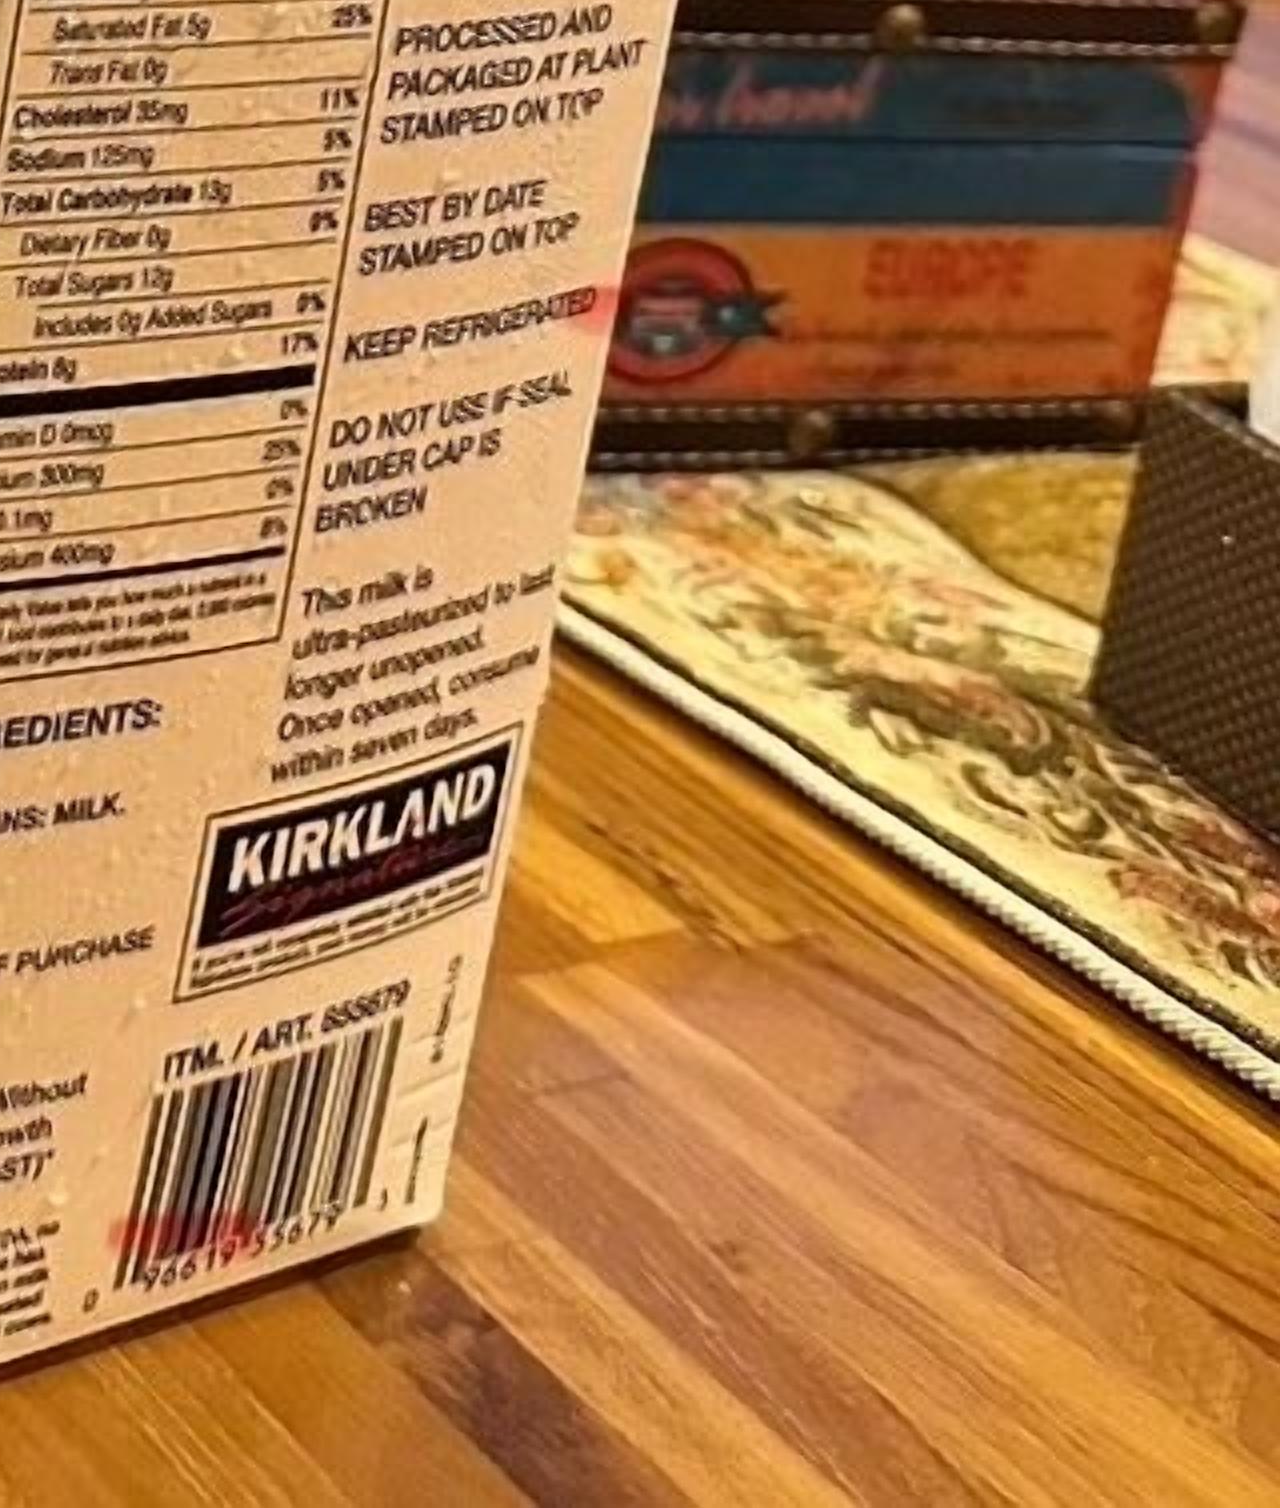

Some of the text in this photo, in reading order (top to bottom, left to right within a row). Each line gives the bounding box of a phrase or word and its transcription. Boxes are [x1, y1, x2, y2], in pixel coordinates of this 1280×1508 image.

[53, 16, 147, 42] Saturated
[151, 13, 184, 39] Fat
[394, 4, 612, 56] PROCESSED AND
[50, 61, 103, 84] Trans
[107, 59, 139, 82] Fat
[388, 39, 649, 100] PACKAGED AT PLANT
[13, 102, 131, 130] Cholesterol
[320, 88, 360, 110] 11%
[380, 88, 604, 145] STAMPED ON TOP
[7, 148, 85, 172] Sodium
[0, 190, 52, 215] Total
[57, 184, 193, 213] Carbohydrate
[364, 179, 548, 232] BEST BY DATE
[20, 232, 86, 256] Dietary
[92, 228, 141, 250] Fiber
[358, 212, 581, 276] STAMPED ON TOP
[15, 272, 64, 296] Total
[67, 272, 133, 297] Sugars
[34, 312, 112, 338] Includes
[145, 306, 204, 329] Added
[211, 299, 272, 325] Sugars
[344, 286, 596, 363] KEEP REFRIGERATED
[329, 416, 372, 449] DO
[376, 404, 436, 440] NOT
[439, 391, 489, 428] USE
[324, 428, 502, 491] UNDER CAP IS
[314, 486, 427, 534] BROKEN
[302, 587, 353, 617] This
[357, 571, 408, 605] milk
[293, 584, 489, 660] ultra-pasteurized
[285, 663, 364, 700] longer
[278, 709, 344, 741] Once
[271, 745, 344, 783] within
[53, 792, 126, 826] MILK.
[228, 764, 496, 893] KIRKLAND
[15, 924, 156, 974] PURCHASE
[164, 1046, 224, 1081] ITM.
[252, 1013, 313, 1055] ART.
